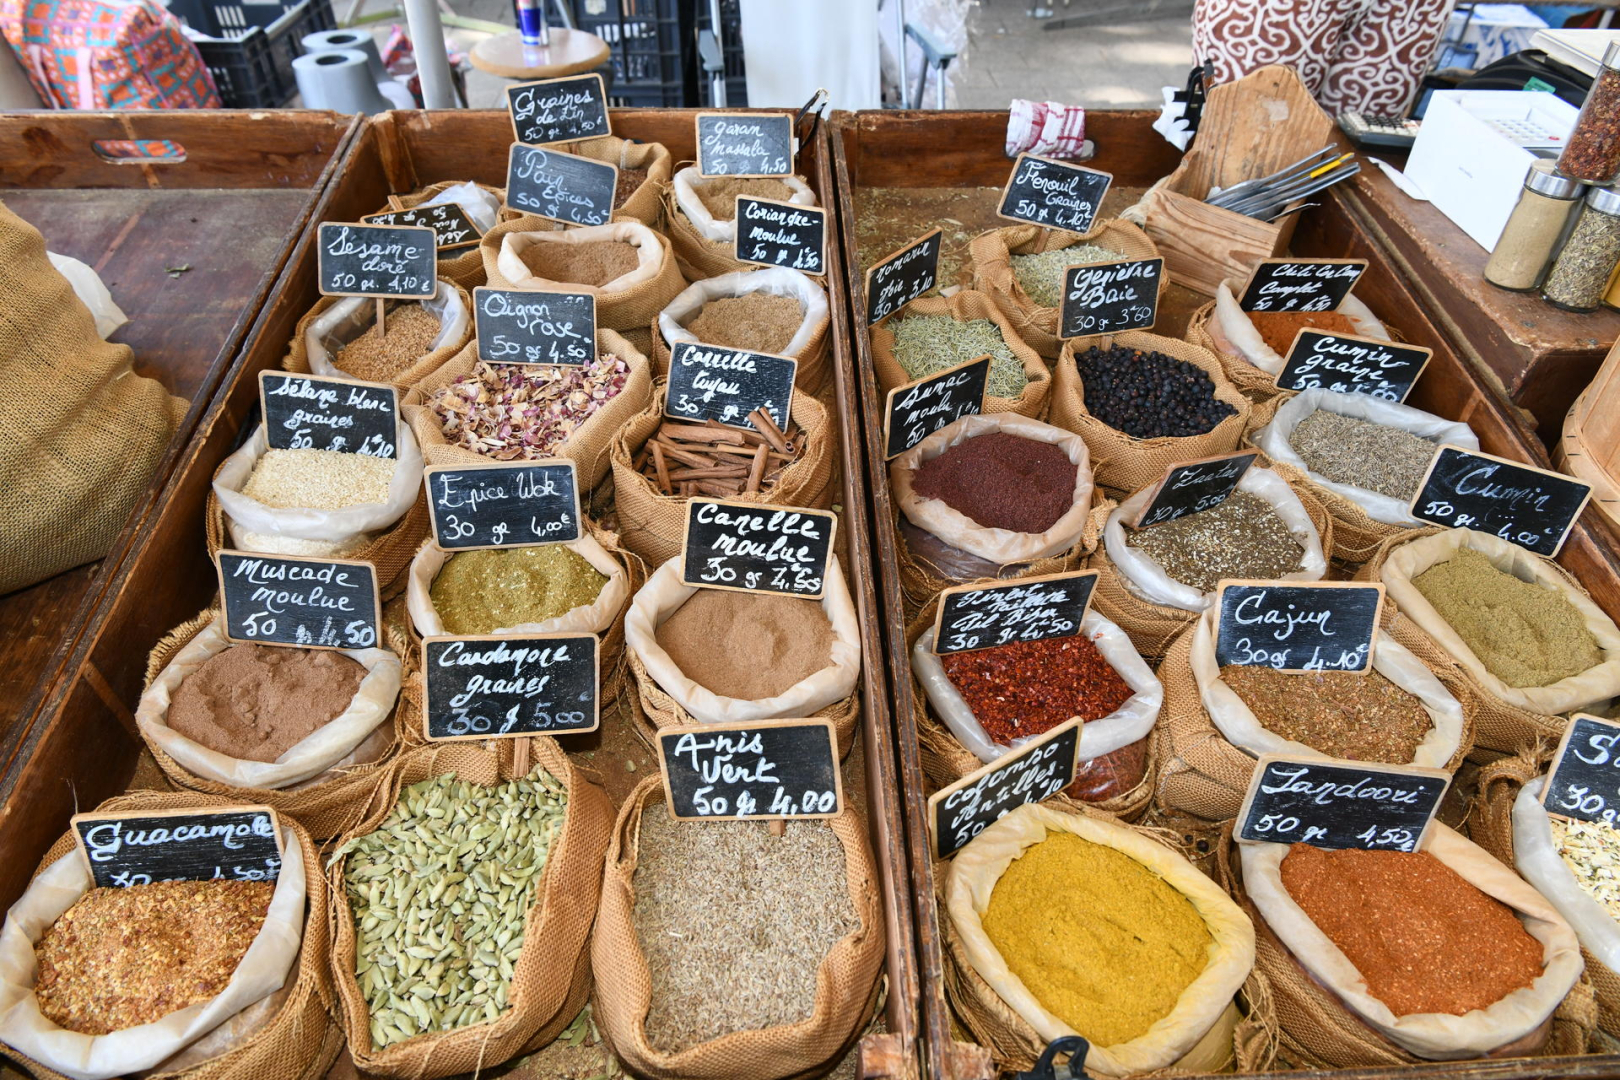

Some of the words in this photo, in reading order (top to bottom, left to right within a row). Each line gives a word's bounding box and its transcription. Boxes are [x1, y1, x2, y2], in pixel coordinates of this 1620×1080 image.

[515, 88, 594, 120] Graines
[536, 109, 557, 124] de
[525, 126, 543, 140] 50
[518, 150, 569, 195] Pain
[711, 158, 727, 174] 50
[1016, 161, 1079, 195] Fenouil
[517, 193, 540, 208] 50
[1015, 199, 1037, 217] 50
[1046, 191, 1091, 211] Graines
[327, 227, 420, 264] Sésame
[750, 243, 767, 260] 50
[362, 256, 409, 274] doré
[331, 273, 355, 288] 50
[1080, 284, 1138, 309] Baie
[1252, 296, 1273, 310] 50
[484, 293, 551, 328] Oignon
[1070, 315, 1095, 332] 30
[529, 318, 582, 338] rose
[489, 335, 520, 356] 50
[1313, 336, 1410, 368] Cumin
[682, 345, 757, 374] Canelle
[341, 387, 390, 412] blanc
[675, 395, 699, 413] 30
[895, 373, 971, 411] Sumac
[283, 409, 354, 429] graines
[290, 428, 313, 449] 50
[906, 421, 926, 448] 50
[438, 474, 509, 512] Epice
[516, 471, 560, 499] Wok
[1455, 466, 1552, 511] Cumin
[697, 503, 820, 540] Canelle
[1424, 501, 1454, 516] 50
[446, 514, 475, 540] 30
[233, 559, 359, 588] Muscade
[700, 556, 737, 581] 30
[745, 571, 763, 589] gr
[956, 583, 1044, 608] Piment
[242, 611, 277, 637] 50
[1234, 590, 1336, 640] Cajun
[947, 632, 980, 650] 30
[1230, 637, 1268, 665] 30
[447, 708, 492, 735] 30
[674, 731, 764, 772] Anis
[701, 753, 780, 784] Vert
[944, 742, 1060, 810] Colombo
[1261, 767, 1425, 805] Tandoori
[692, 785, 728, 815] 50
[954, 820, 987, 849] 50
[1254, 813, 1299, 833] 50
[85, 815, 275, 862] Guacamole
